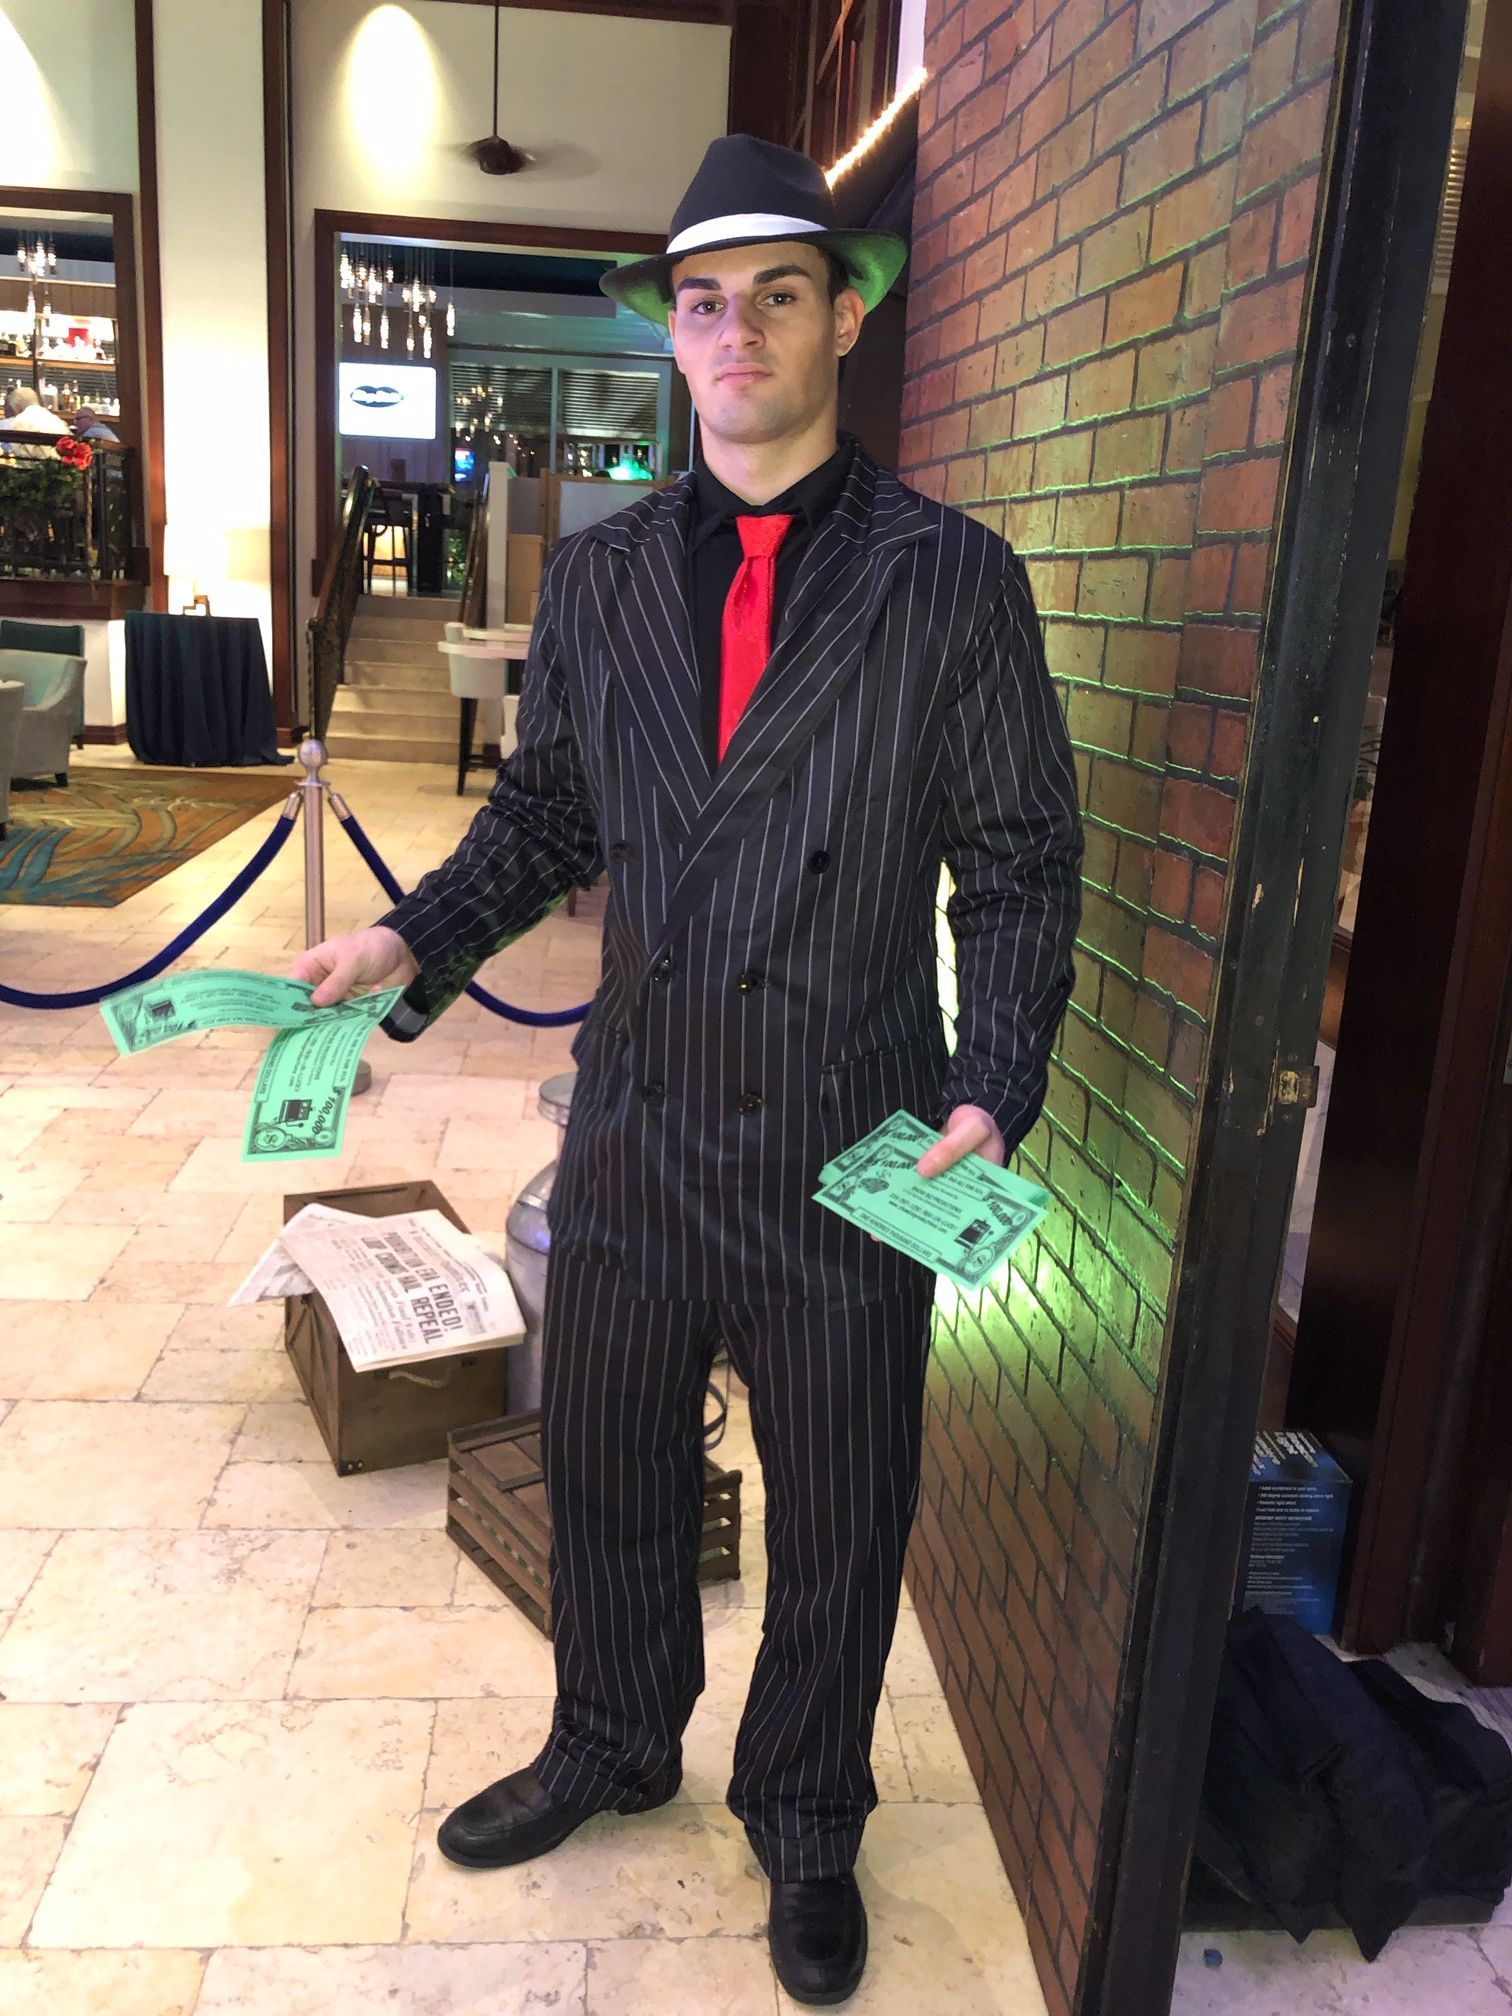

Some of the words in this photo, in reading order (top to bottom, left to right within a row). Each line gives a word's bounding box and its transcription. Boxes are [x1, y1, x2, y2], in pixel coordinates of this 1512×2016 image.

[311, 1096, 336, 1135] 100,000
[410, 1296, 443, 1344] REPEAL
[429, 1284, 464, 1332] ENDED!
